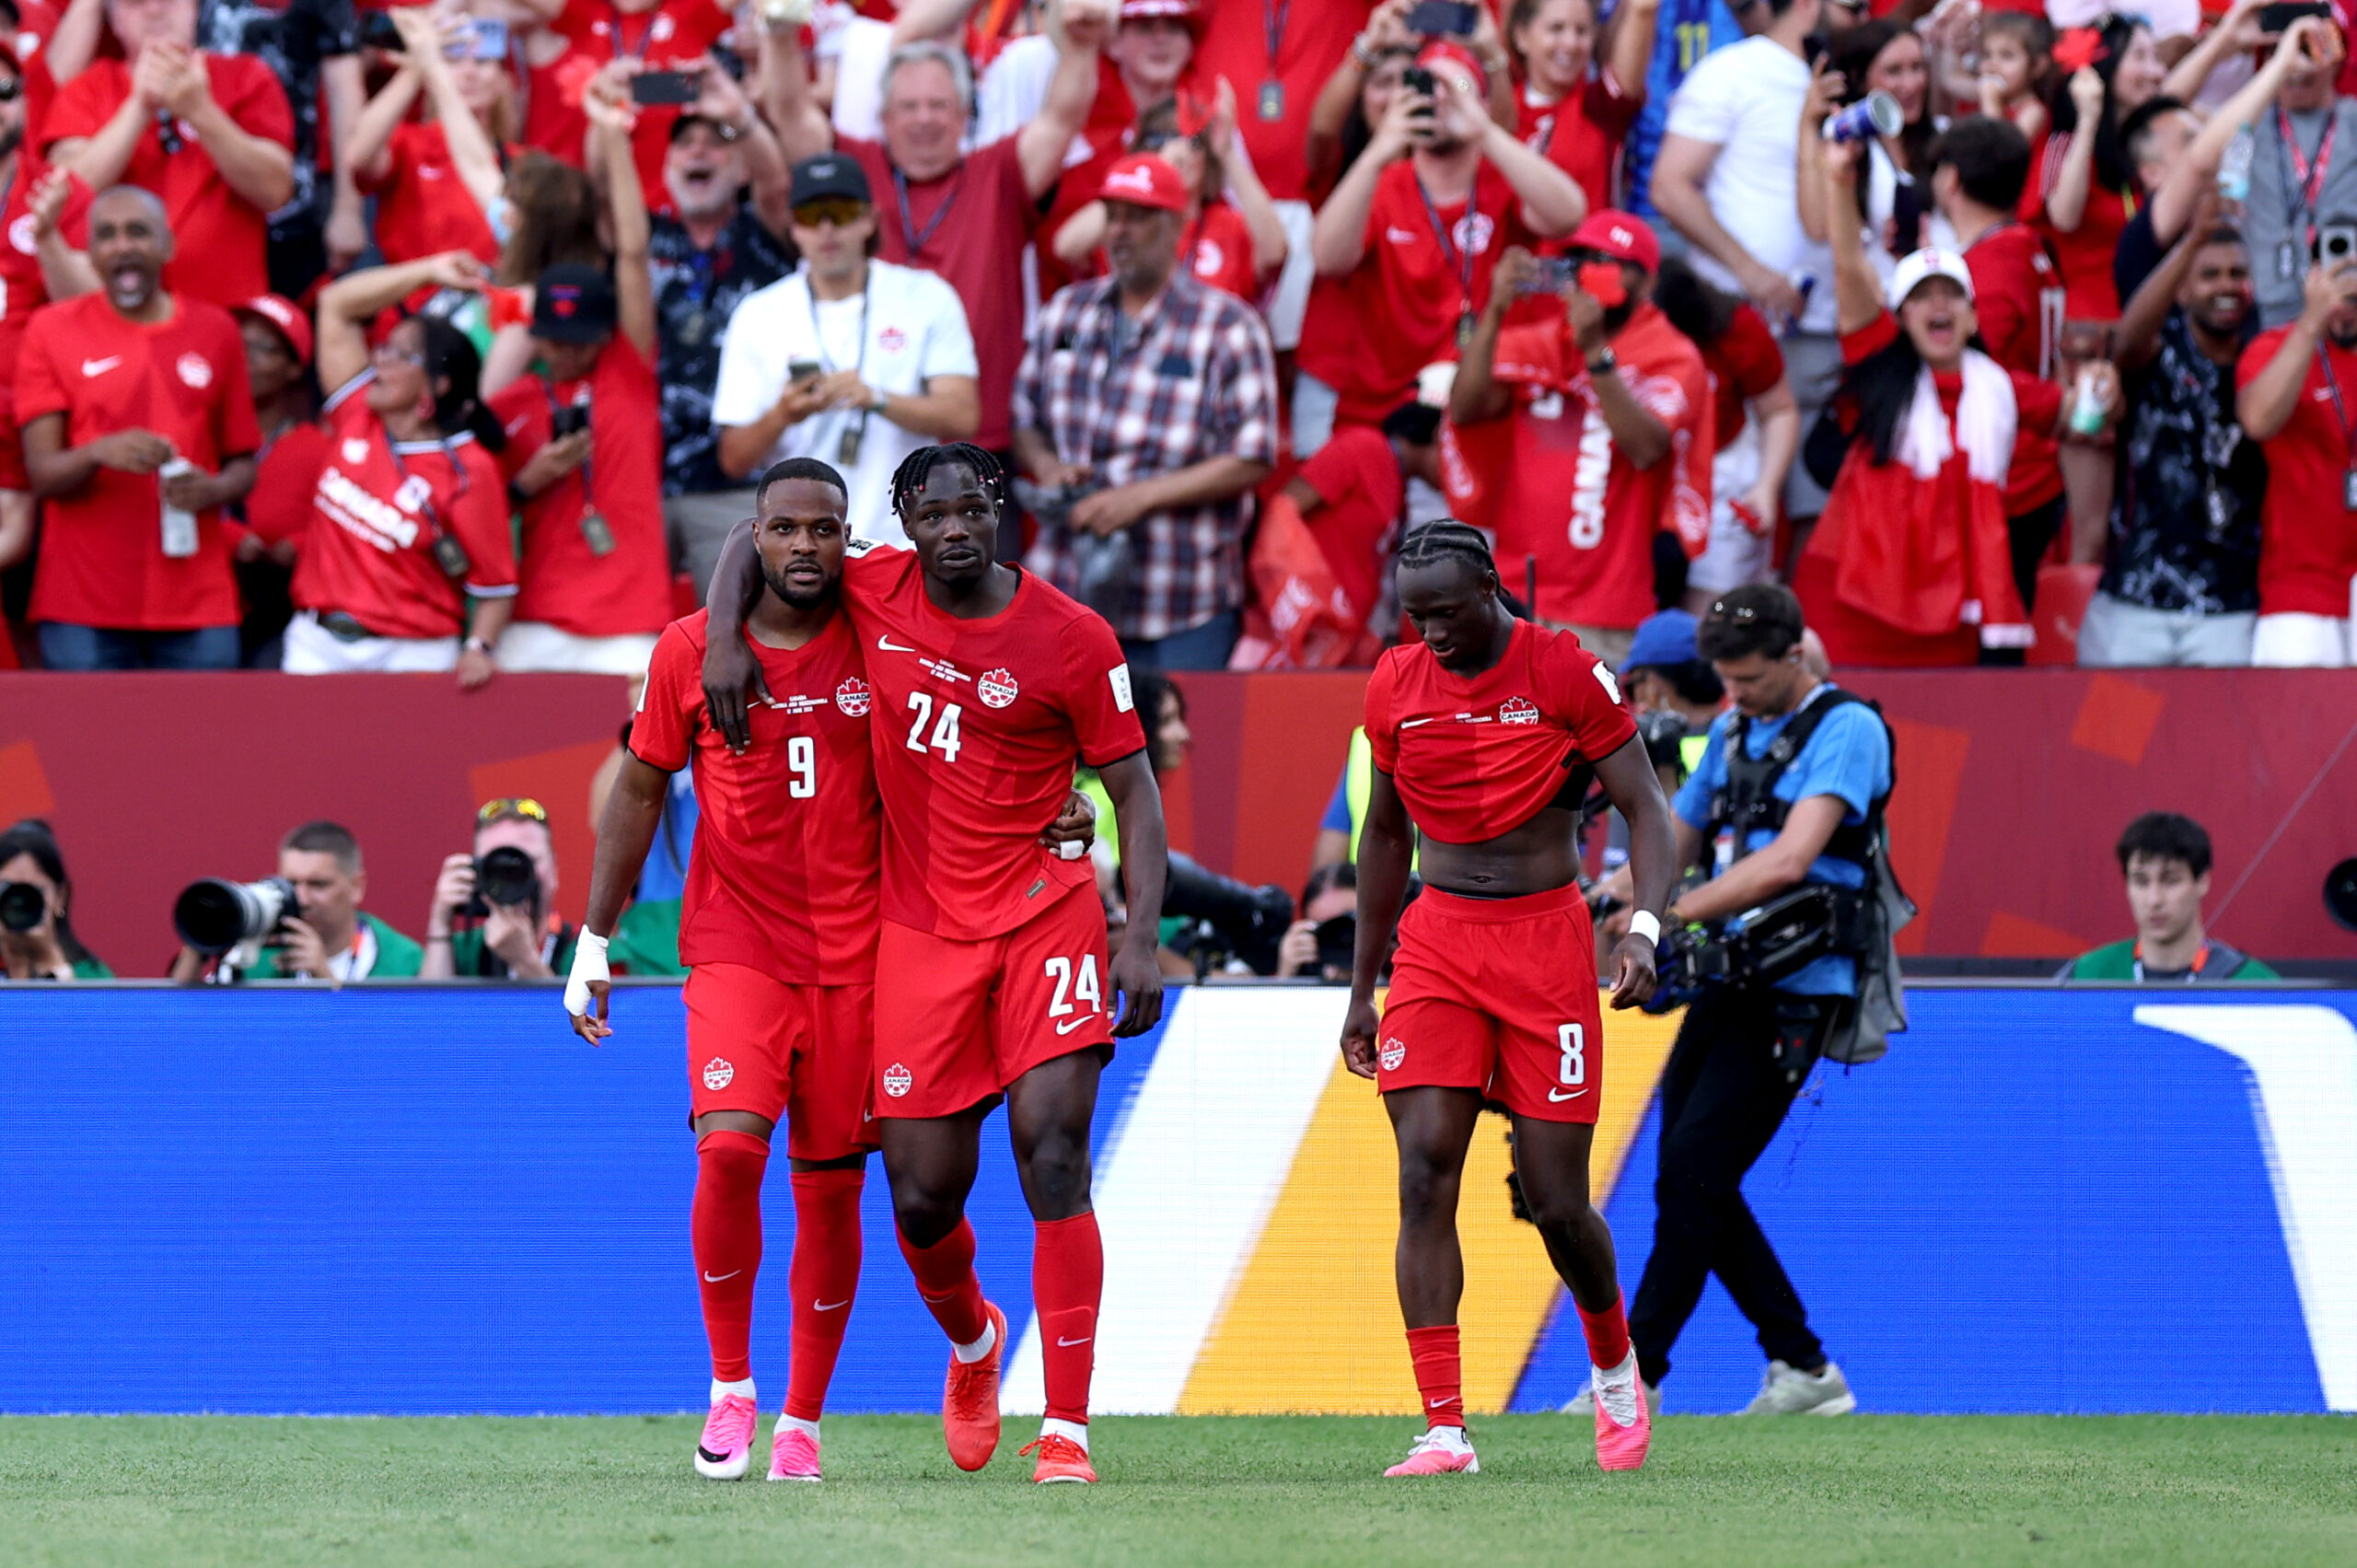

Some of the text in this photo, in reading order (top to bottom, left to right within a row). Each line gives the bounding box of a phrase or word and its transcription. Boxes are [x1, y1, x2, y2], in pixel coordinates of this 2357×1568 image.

[980, 680, 1015, 696] CANADA
[1501, 712, 1537, 720] CANADA
[906, 691, 962, 762] 24
[788, 736, 816, 798] 9
[1045, 953, 1101, 1018] 24
[1558, 1022, 1585, 1085] 8
